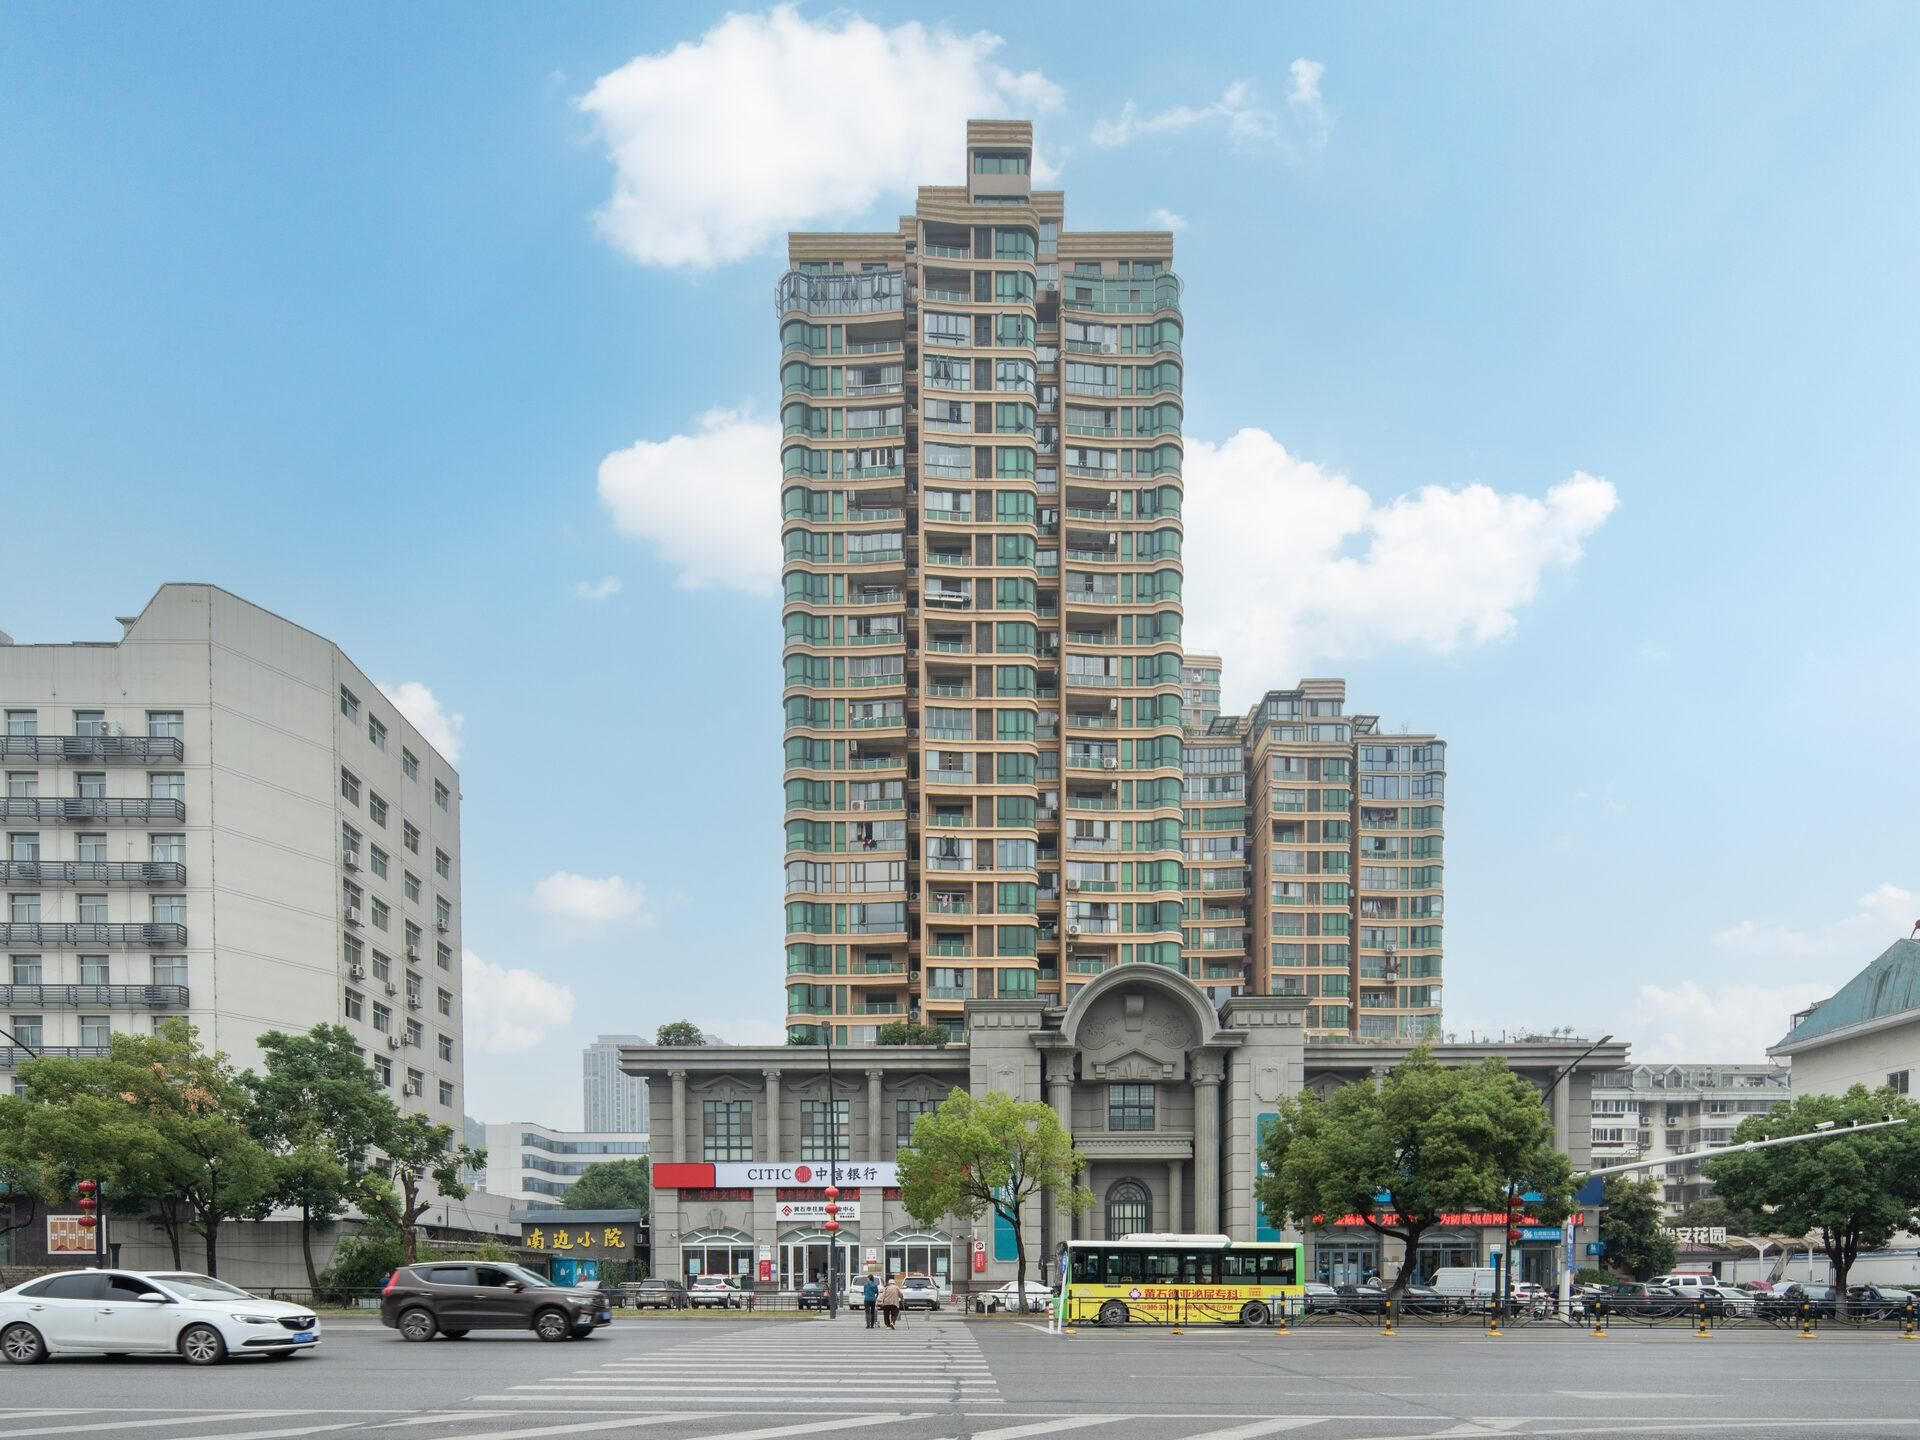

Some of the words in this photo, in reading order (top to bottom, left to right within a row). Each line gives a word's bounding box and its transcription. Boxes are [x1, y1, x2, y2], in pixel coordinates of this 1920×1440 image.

[747, 1168, 791, 1181] CITIC
[815, 1167, 877, 1182] 中信银行
[527, 1228, 625, 1249] 南边小院
